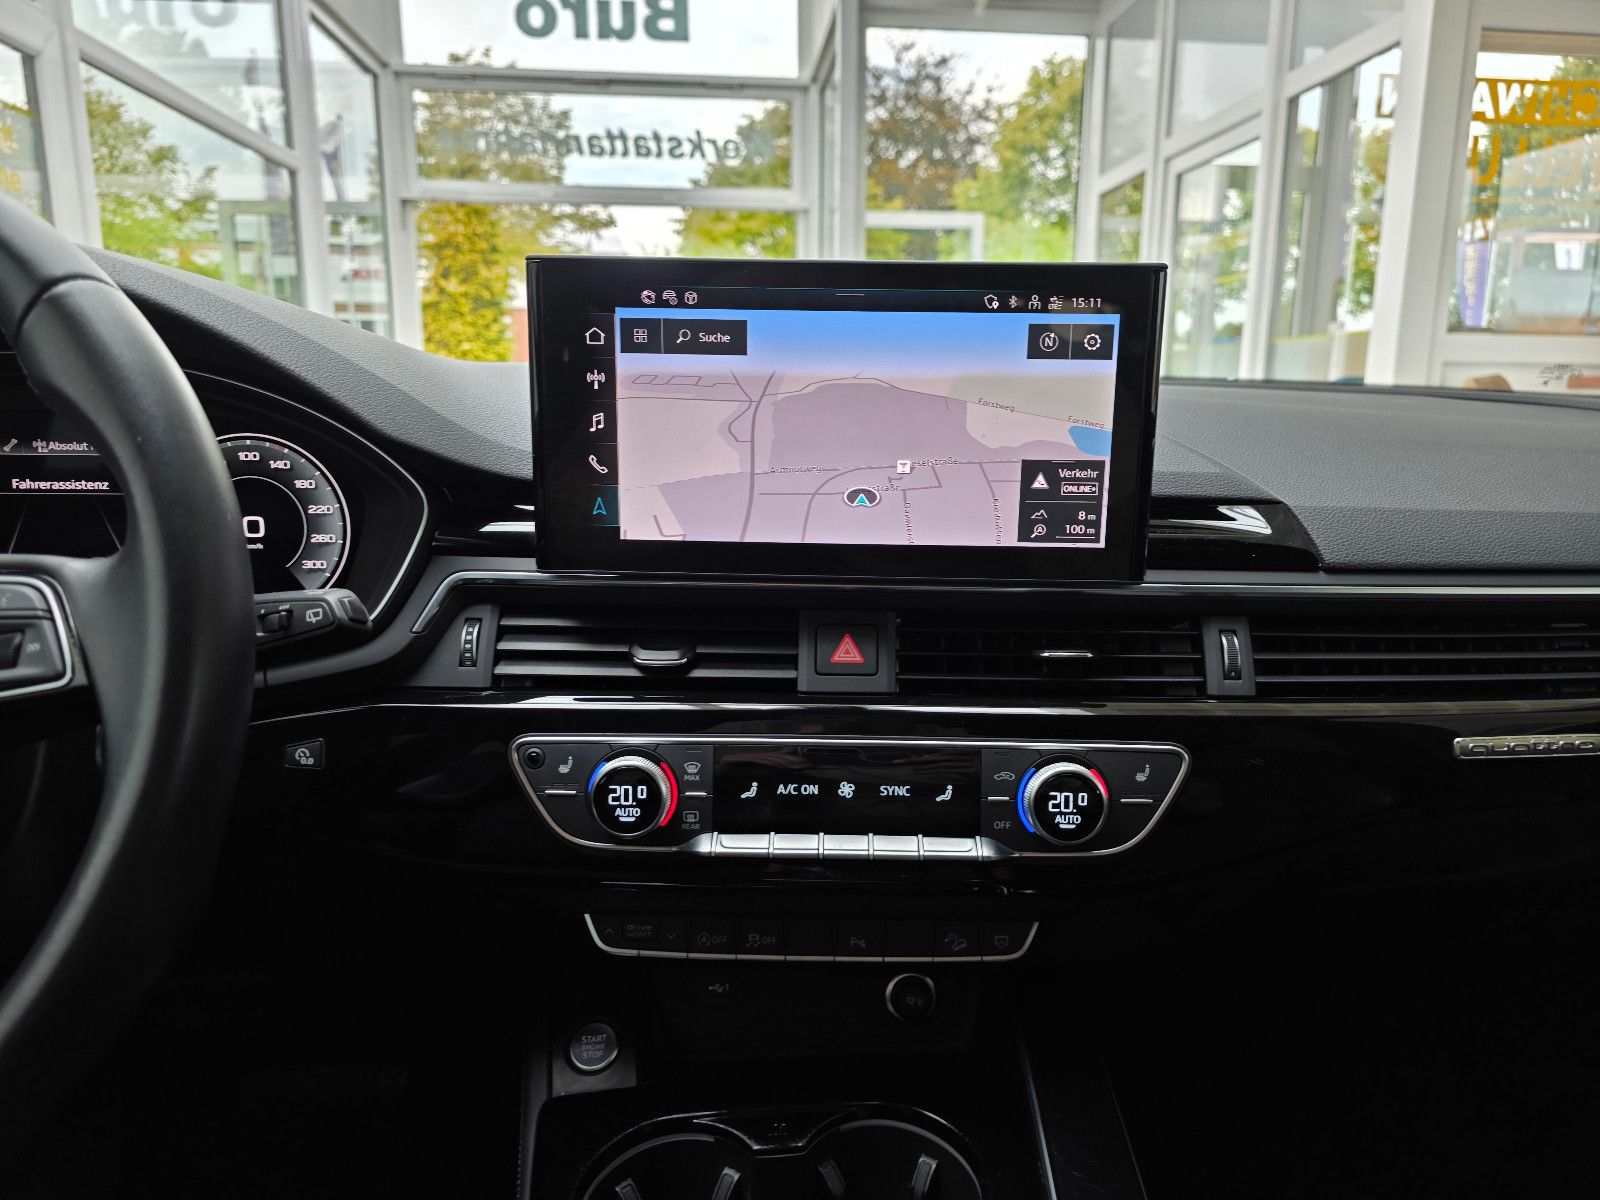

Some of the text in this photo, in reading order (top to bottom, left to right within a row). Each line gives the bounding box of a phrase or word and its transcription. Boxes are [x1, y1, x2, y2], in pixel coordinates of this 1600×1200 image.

[1071, 297, 1102, 308] 15:11
[698, 332, 731, 343] Suche
[978, 397, 1015, 413] Forstweg
[1067, 415, 1105, 430] Forstweg
[48, 441, 89, 451] Absolut
[237, 451, 260, 461] 100
[269, 460, 291, 470] 140
[1058, 468, 1100, 478] Verkehr
[11, 478, 110, 490] Fahrerassistenz
[294, 479, 316, 489] 180
[308, 504, 333, 514] 220
[1078, 511, 1086, 520] 8
[1065, 524, 1085, 534] 100
[310, 533, 336, 543] 260
[301, 560, 327, 569] 300
[776, 783, 819, 796] A/C ON
[879, 785, 911, 797] SYNC
[614, 807, 641, 818] AUTO
[1054, 814, 1081, 825] AUTO
[993, 820, 1012, 830] OFF
[626, 923, 653, 931] drive
[711, 935, 728, 944] OFF
[761, 936, 777, 945] OFF
[581, 1034, 608, 1044] START
[582, 1050, 604, 1059] STOP
